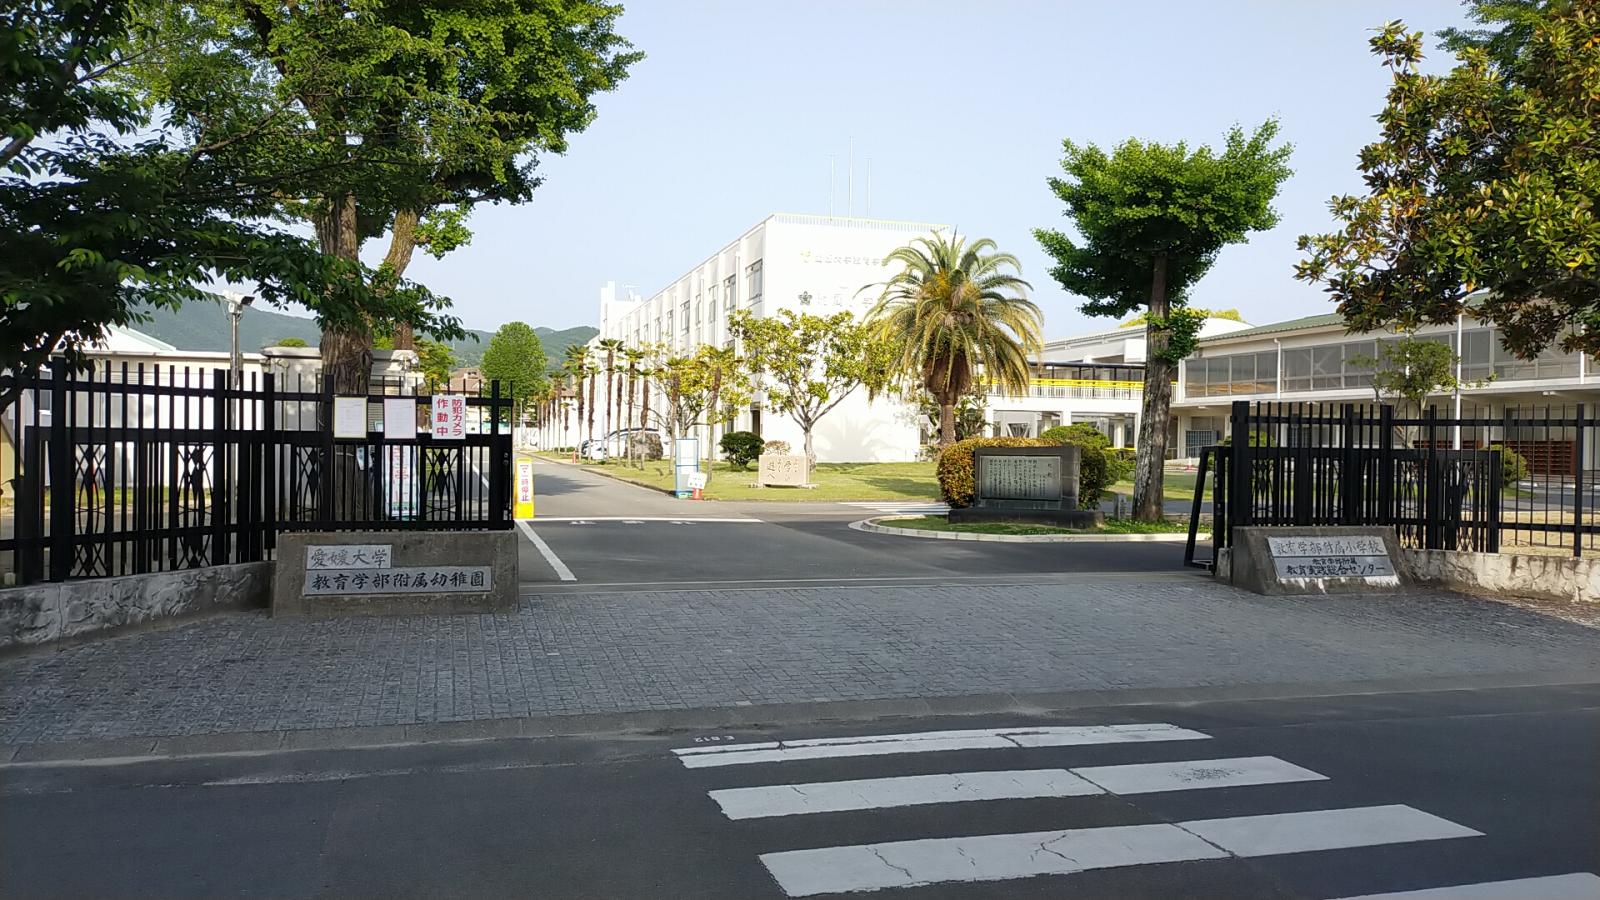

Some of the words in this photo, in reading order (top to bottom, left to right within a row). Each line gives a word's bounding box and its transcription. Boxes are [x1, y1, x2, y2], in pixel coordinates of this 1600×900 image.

[436, 398, 449, 437] 作動中
[451, 398, 463, 437] 防犯カメラ
[310, 548, 388, 569] 愛媛大学
[1286, 563, 1385, 577] 教育実践総合センター
[311, 571, 485, 591] 教育学部附属幼稚園
